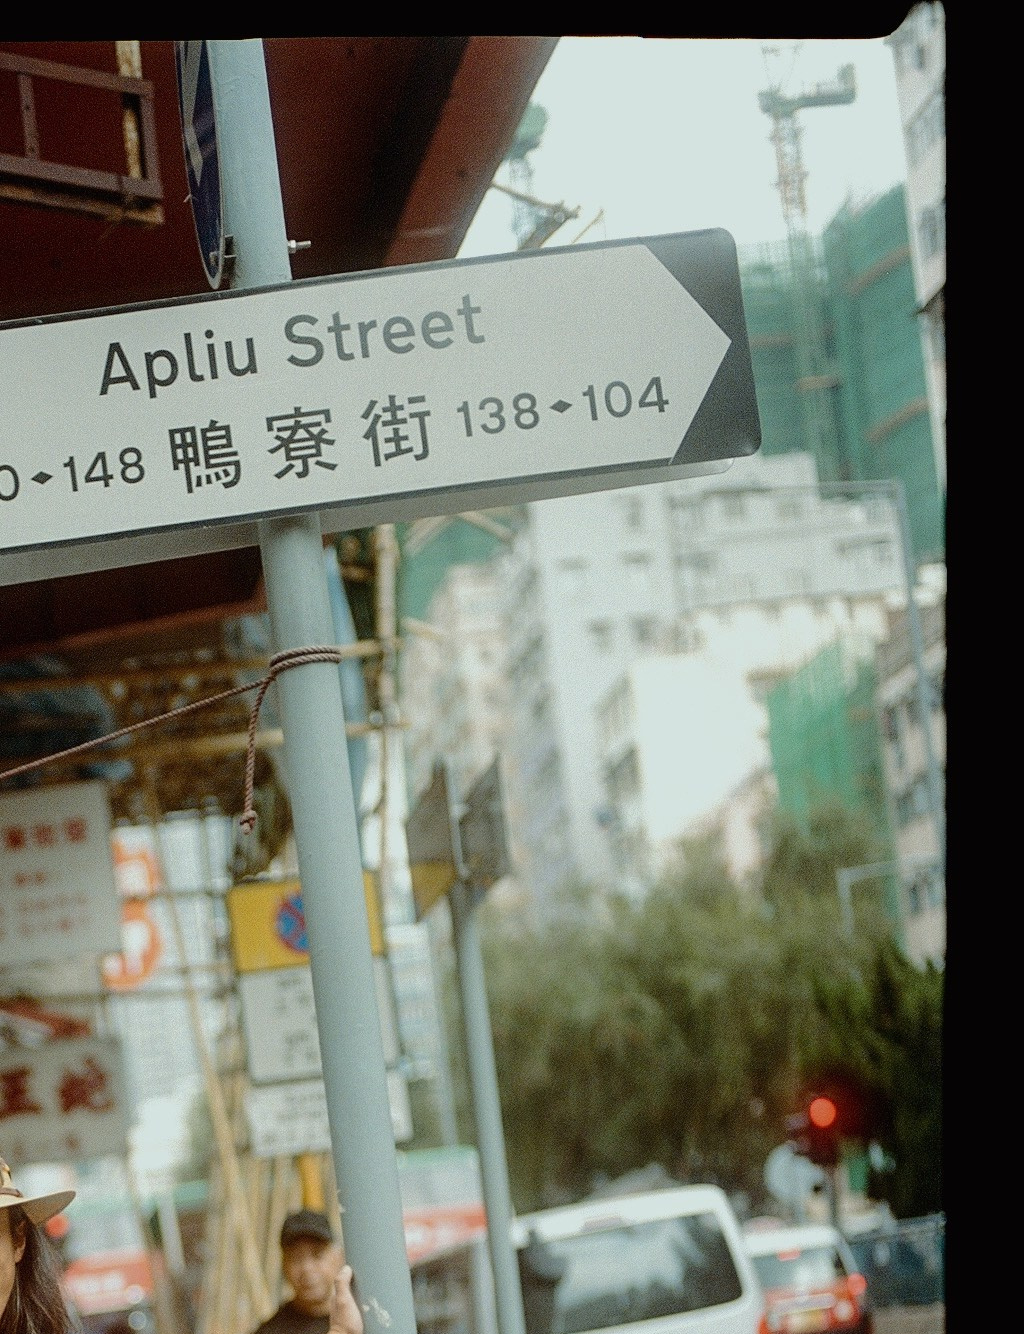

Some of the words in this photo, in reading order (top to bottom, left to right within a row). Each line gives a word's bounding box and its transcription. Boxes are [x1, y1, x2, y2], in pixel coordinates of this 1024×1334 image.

[98, 332, 259, 399] Apliu
[285, 294, 485, 369] Street
[62, 446, 146, 494] 148
[168, 393, 432, 494] 鴨寮街
[455, 392, 540, 439] 138
[580, 376, 670, 422] 104
